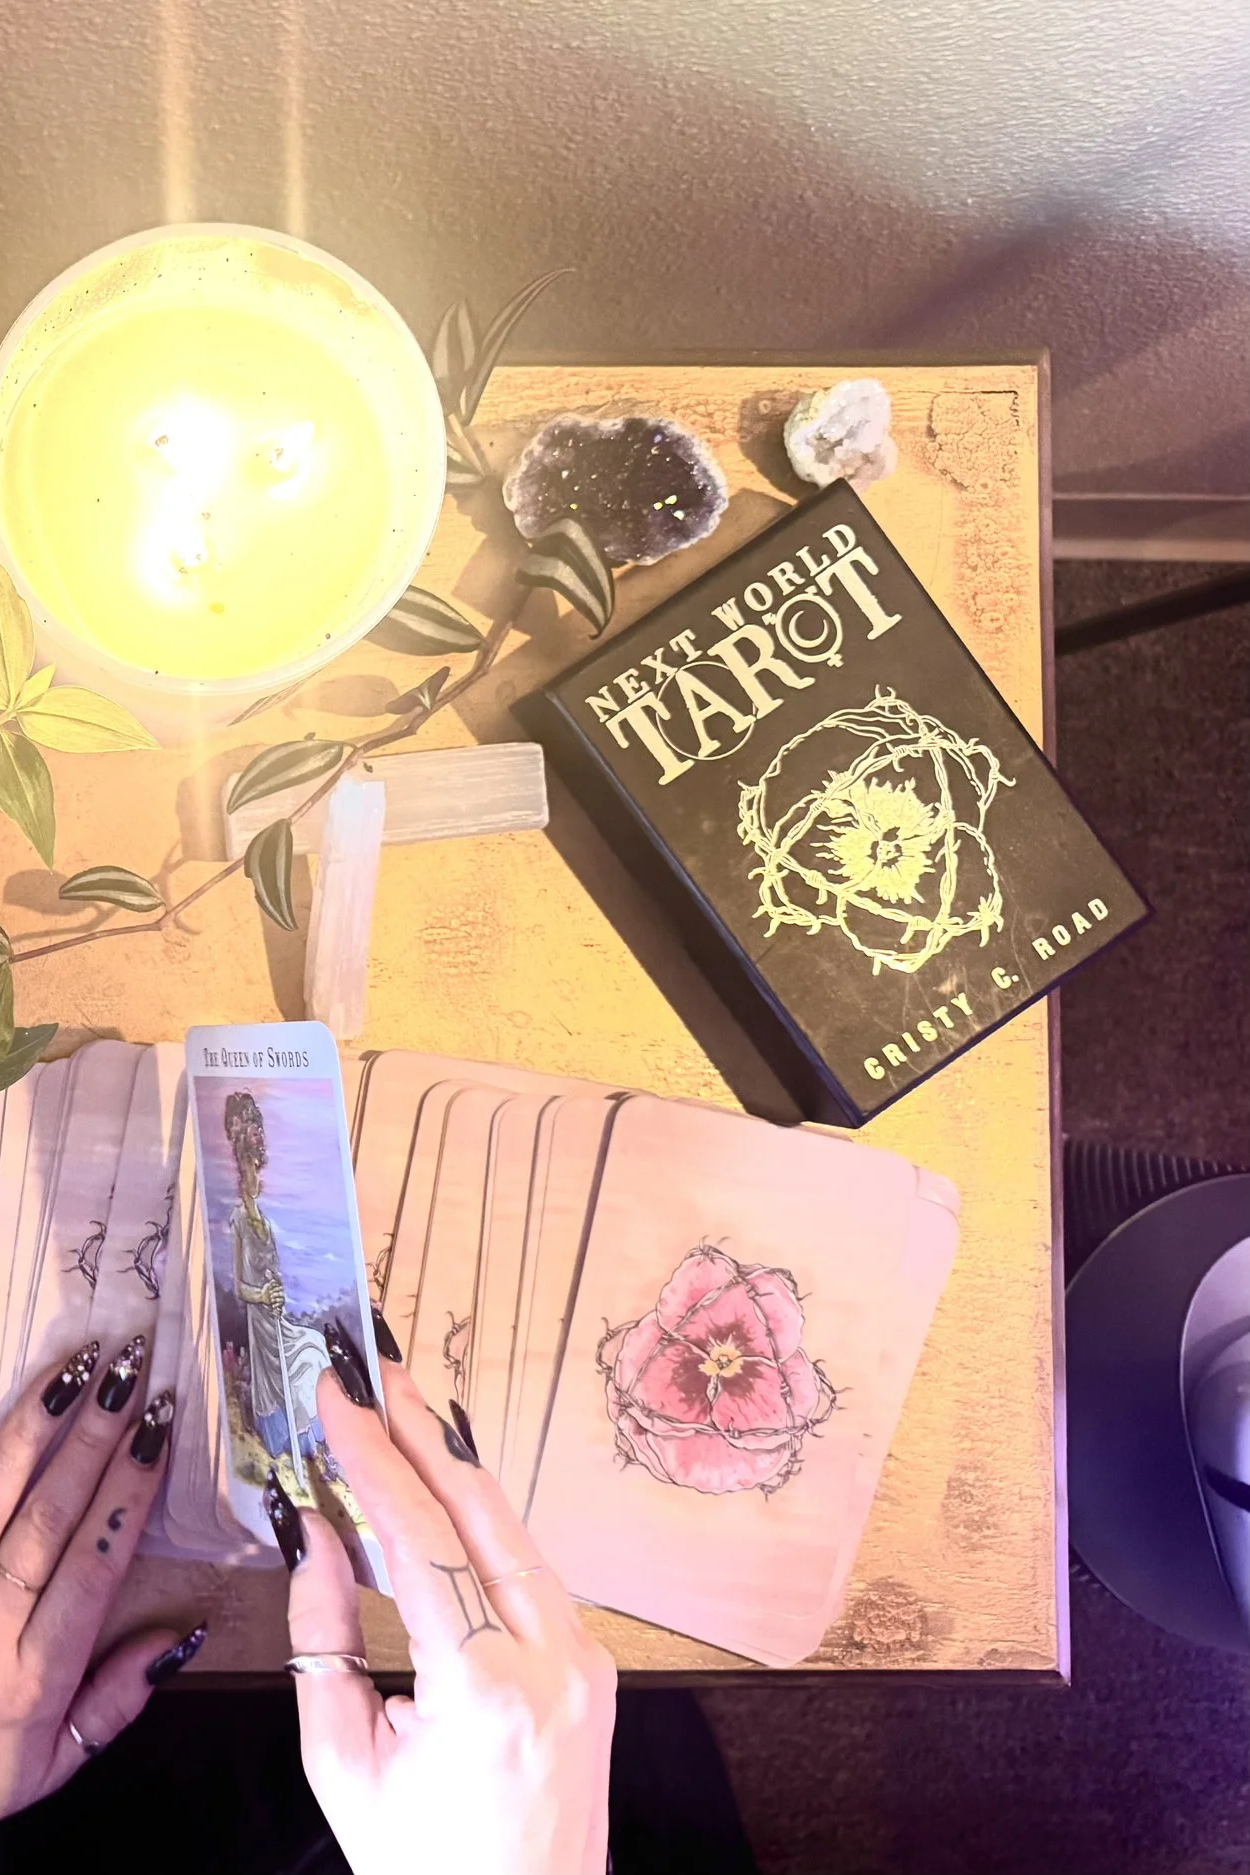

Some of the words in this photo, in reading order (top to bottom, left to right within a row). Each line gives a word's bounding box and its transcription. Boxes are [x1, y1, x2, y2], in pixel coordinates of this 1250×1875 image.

[585, 629, 703, 723] NEXT
[711, 523, 857, 632] WORLD
[605, 546, 902, 786] TAROT
[863, 992, 974, 1080] CRISTY
[990, 966, 1020, 990] C.
[1031, 898, 1109, 961] ROAD
